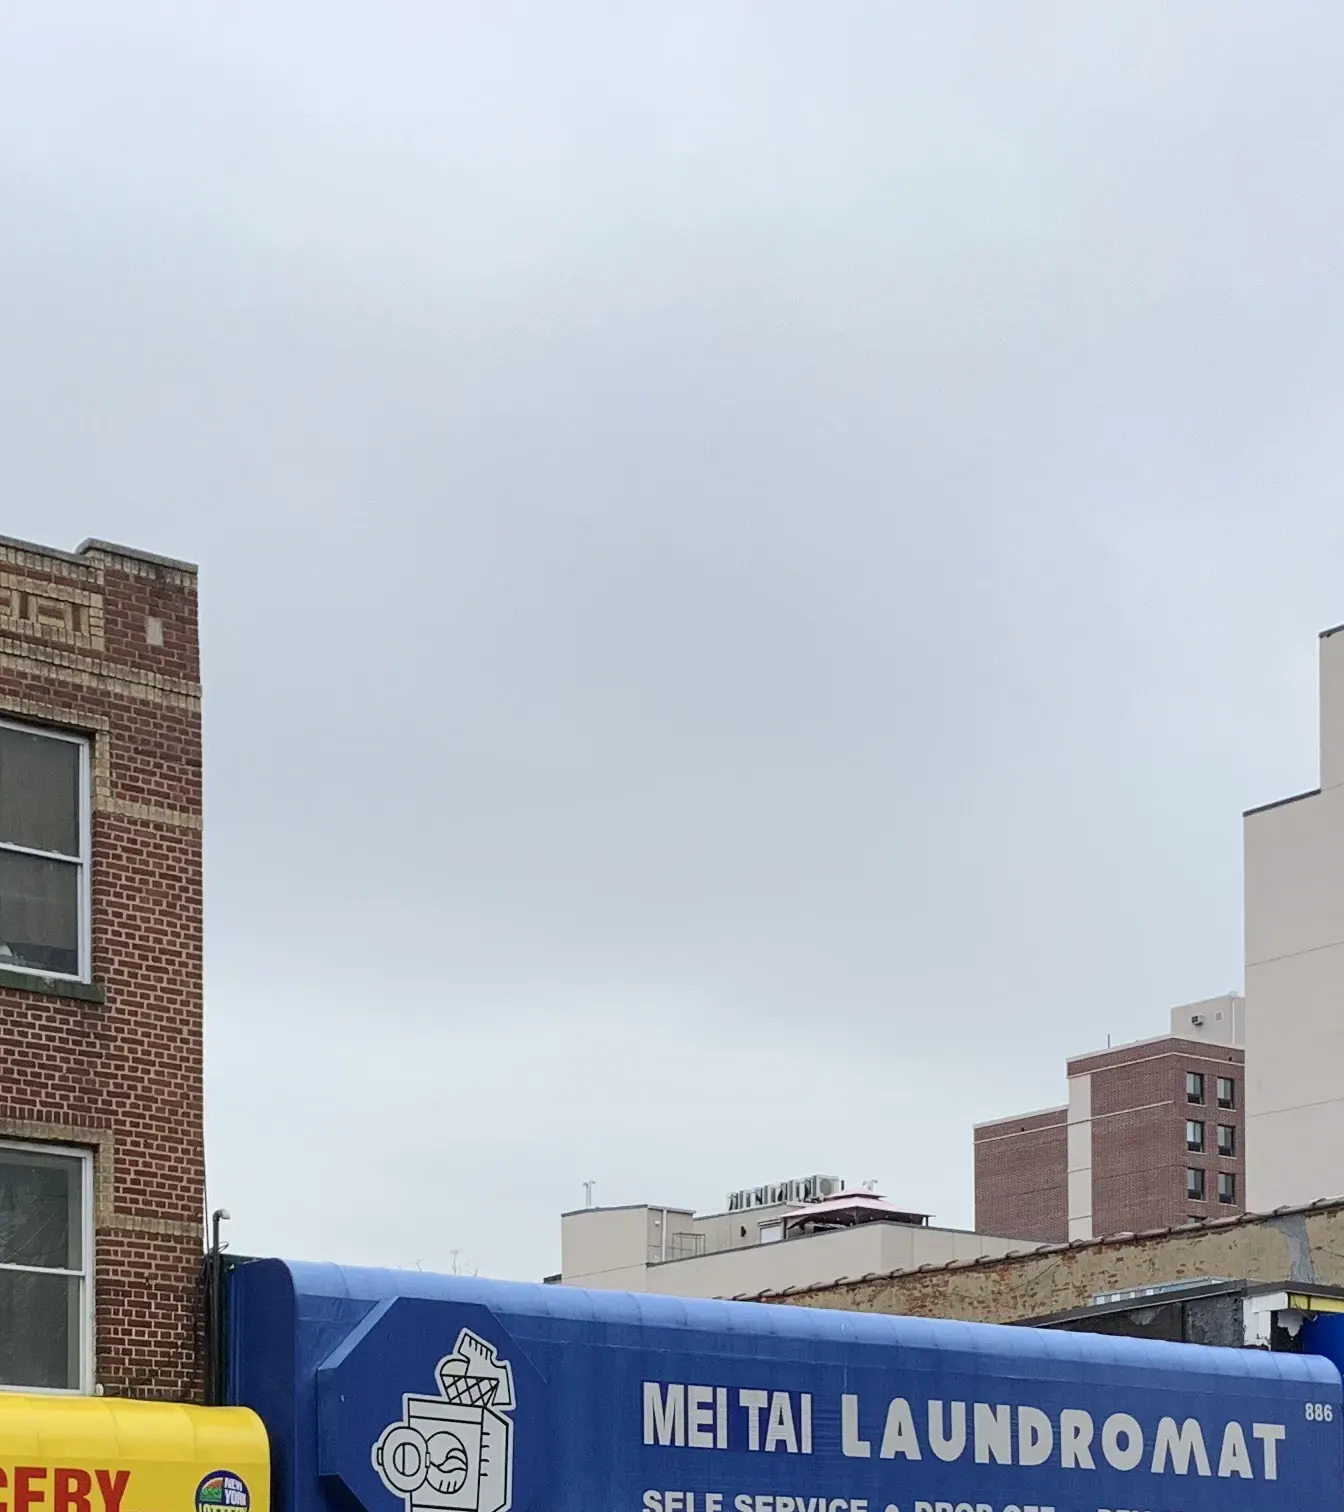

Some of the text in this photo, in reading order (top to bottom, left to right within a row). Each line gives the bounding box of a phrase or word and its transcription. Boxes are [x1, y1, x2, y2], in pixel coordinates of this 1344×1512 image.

[1304, 1402, 1333, 1423] 886
[642, 1381, 1286, 1481] MEI TAI LAUNDROMAT
[224, 1477, 243, 1492] NEW
[224, 1489, 247, 1506] YORK
